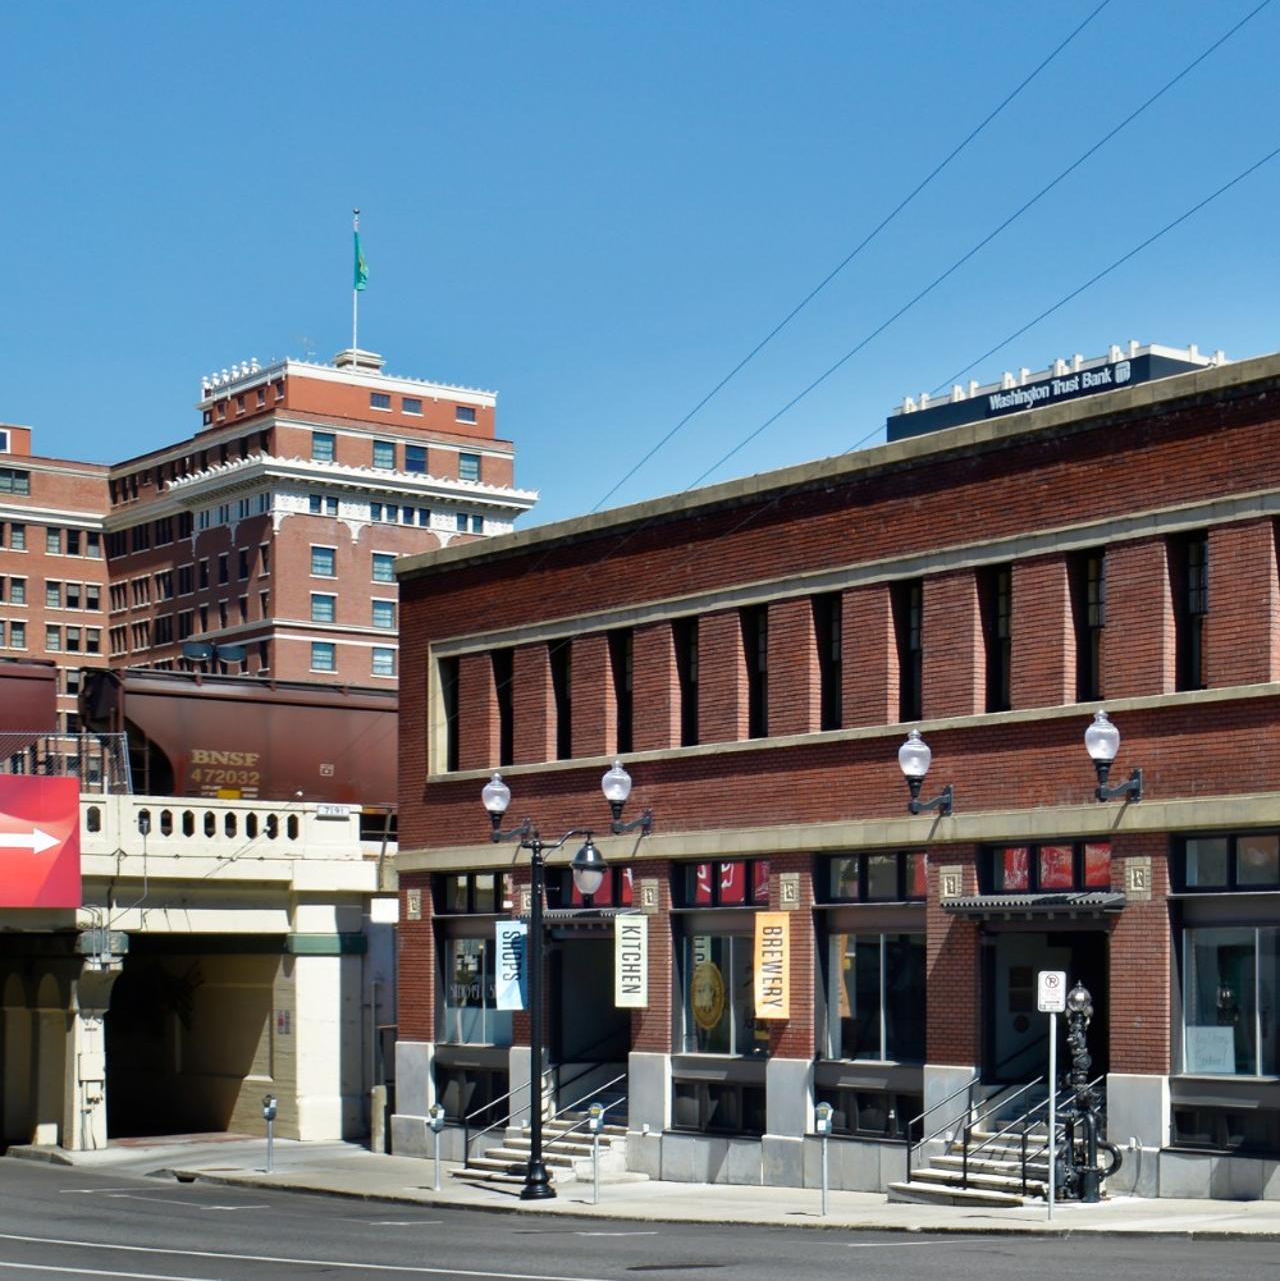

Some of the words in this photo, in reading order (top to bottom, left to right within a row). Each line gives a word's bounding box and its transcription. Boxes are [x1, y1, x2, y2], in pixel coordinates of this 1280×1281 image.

[989, 384, 1050, 410] Washington
[1051, 376, 1080, 396] Trust
[1082, 368, 1112, 389] Bank
[191, 749, 260, 767] BNSF
[191, 768, 261, 785] 472032
[502, 930, 521, 981] SHOPS
[621, 925, 641, 994] KITCHEN
[762, 925, 783, 1008] BREWERY
